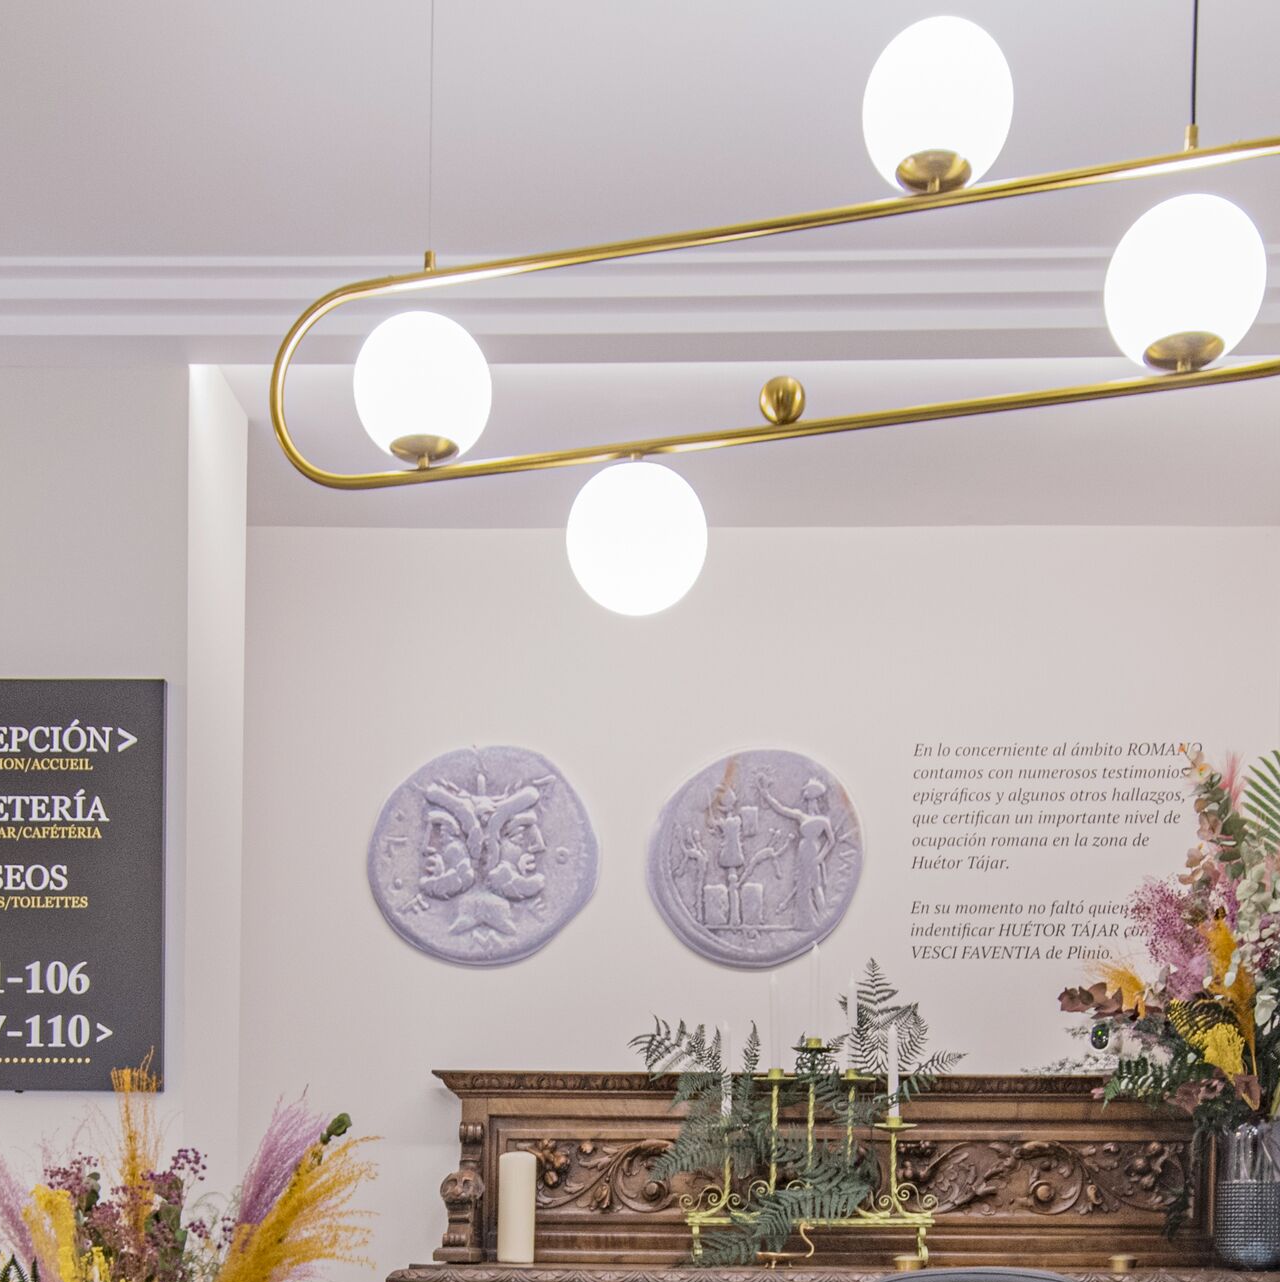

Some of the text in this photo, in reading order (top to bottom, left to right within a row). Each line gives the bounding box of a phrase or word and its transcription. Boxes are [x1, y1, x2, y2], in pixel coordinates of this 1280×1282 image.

[913, 743, 933, 757] En
[937, 742, 951, 757] lo
[954, 742, 1049, 757] concerniente
[1052, 741, 1068, 757] al
[1070, 741, 1123, 757] ámbito
[912, 764, 1187, 780] contamos con numerosos testimonio
[912, 787, 1185, 806] epigráficos y algunos otros hallazgos,
[912, 809, 1181, 828] que certifican un importante nivel de
[911, 832, 1150, 851] ocupación romana en la zona de
[911, 854, 1009, 873] Huétor Tájar.
[910, 900, 930, 915] En
[933, 904, 951, 915] su
[954, 902, 1024, 915] momento
[1027, 903, 1047, 915] no
[1049, 899, 1085, 917] faltó
[910, 922, 996, 939] indentificar
[998, 920, 1066, 937] HUÉTOR
[1071, 920, 1120, 939] TÁJAR
[911, 945, 1113, 960] VESCI FAVENTIA de Plinio.
